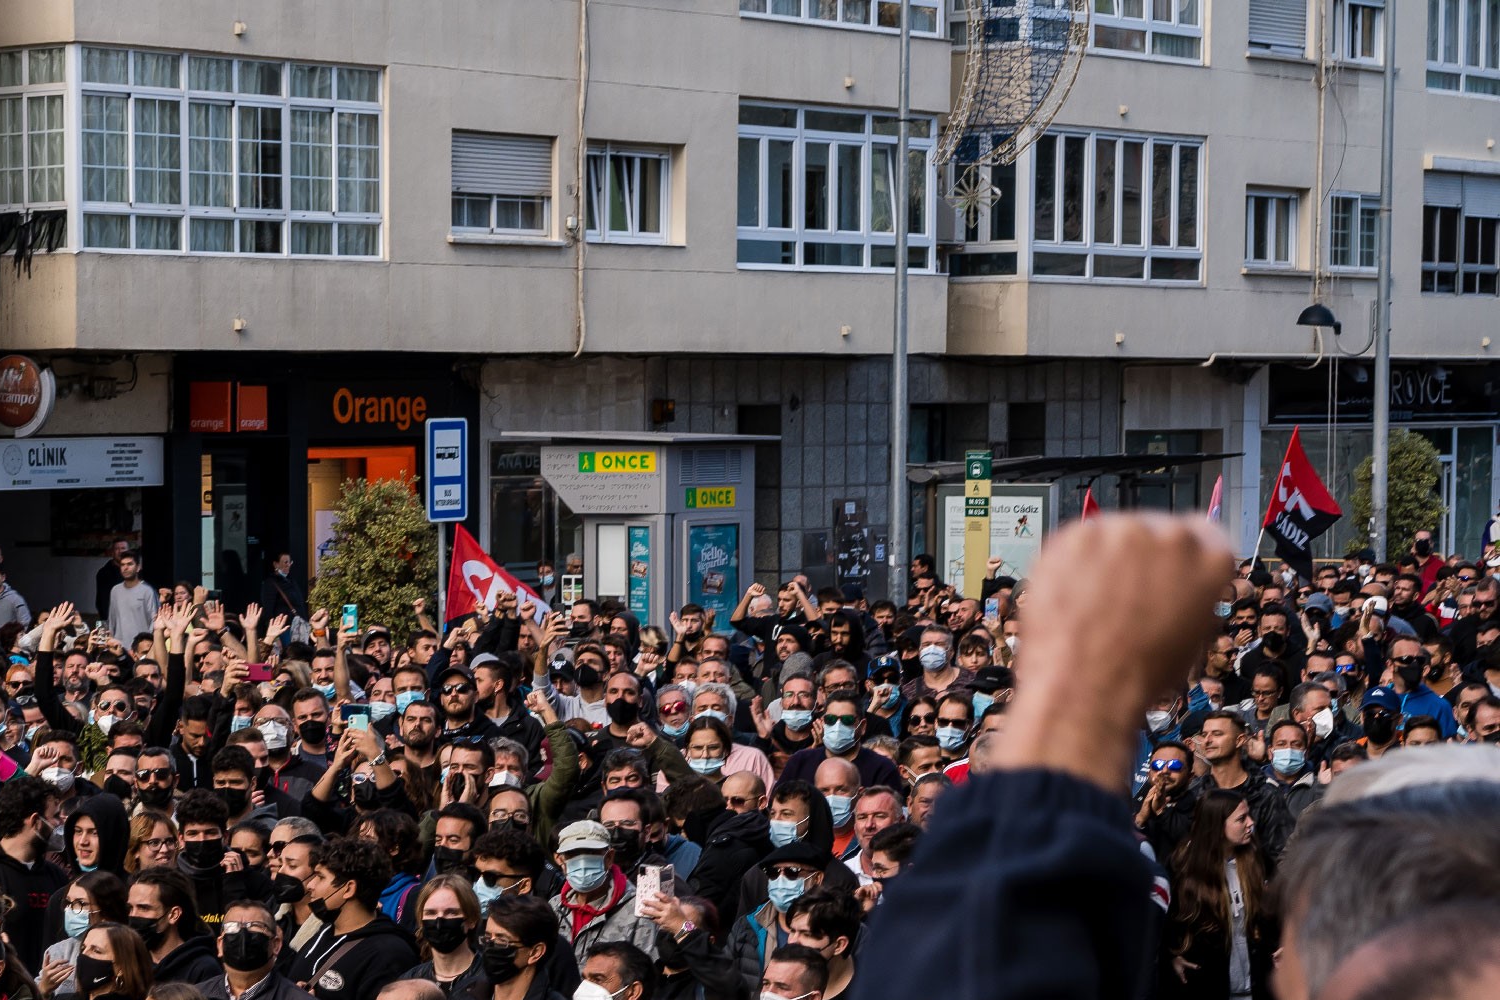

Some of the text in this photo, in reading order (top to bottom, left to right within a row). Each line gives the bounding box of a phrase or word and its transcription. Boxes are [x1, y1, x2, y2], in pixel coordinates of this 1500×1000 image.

[1391, 370, 1453, 405] ROYCE
[333, 387, 427, 431] Orange
[190, 418, 224, 430] orange
[240, 418, 265, 429] orange
[601, 454, 650, 470] ONCE
[700, 489, 732, 505] ONCE
[1013, 504, 1039, 514] Cádiz
